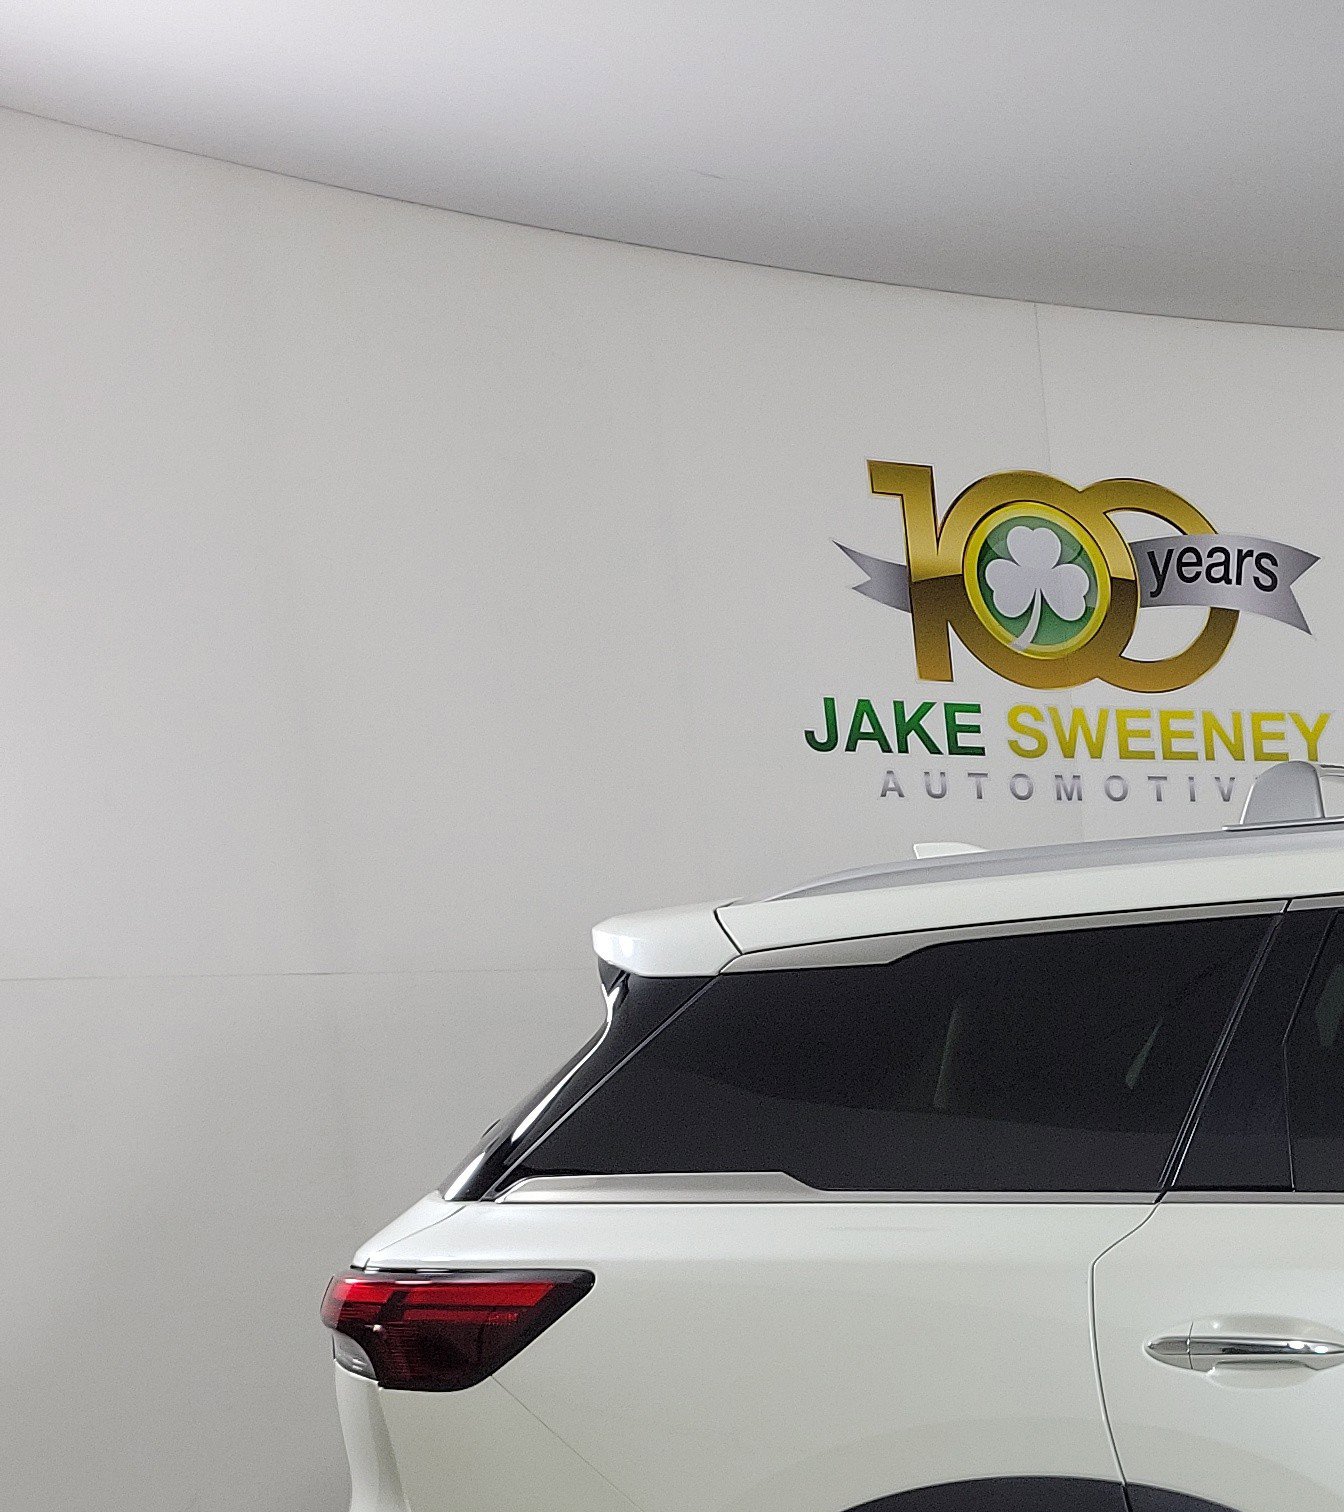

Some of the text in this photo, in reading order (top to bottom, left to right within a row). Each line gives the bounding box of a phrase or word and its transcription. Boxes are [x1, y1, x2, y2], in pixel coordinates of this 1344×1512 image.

[867, 459, 1280, 694] 100 years
[803, 697, 1332, 763] JAKE SWEENEY
[880, 770, 1258, 803] AUTOMOTIV
